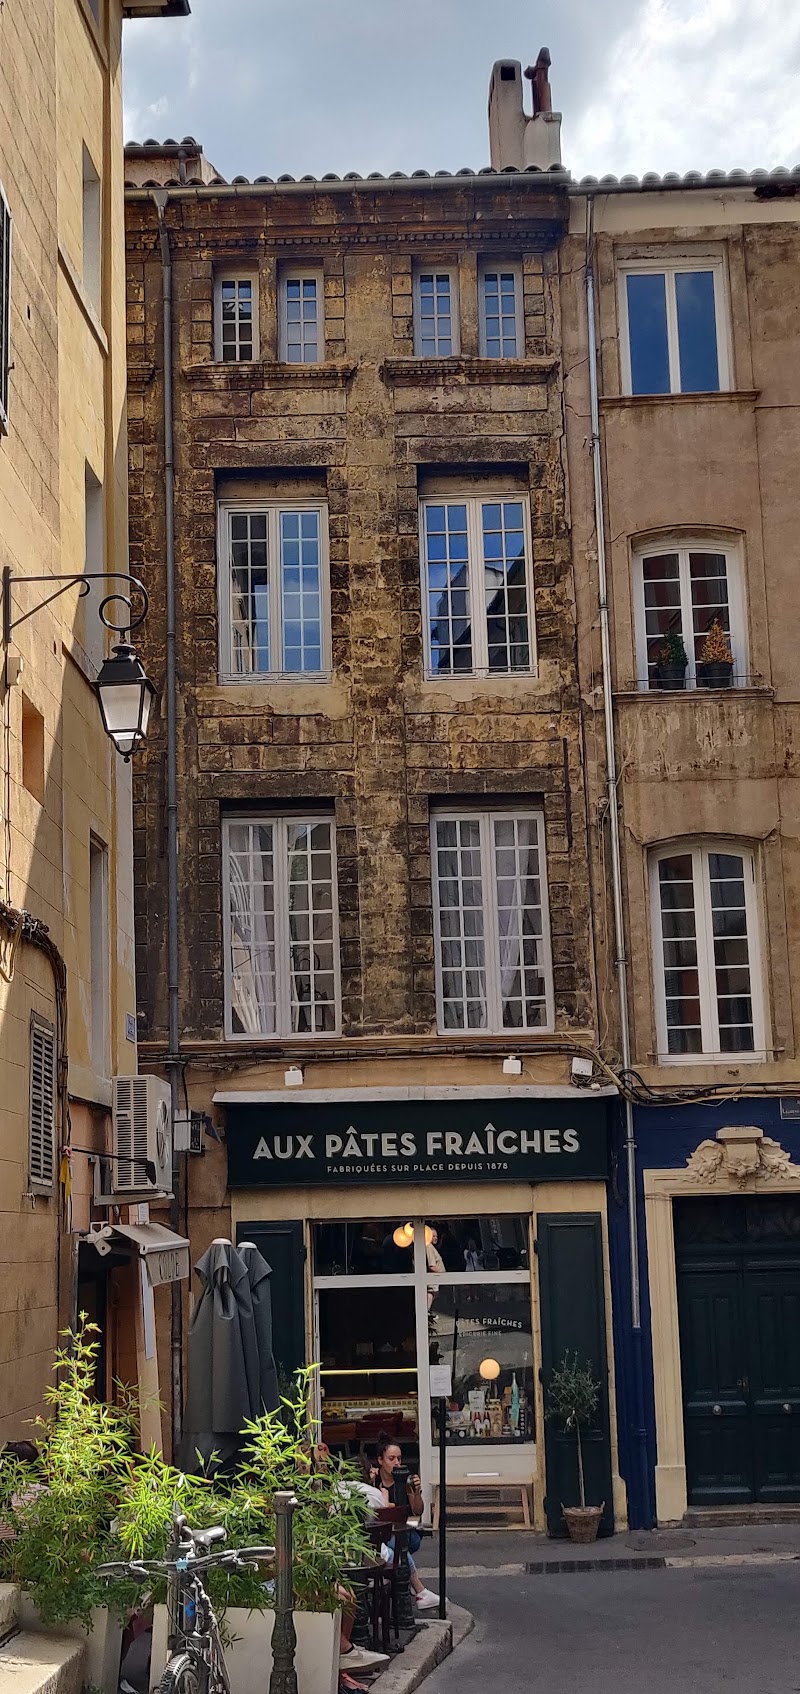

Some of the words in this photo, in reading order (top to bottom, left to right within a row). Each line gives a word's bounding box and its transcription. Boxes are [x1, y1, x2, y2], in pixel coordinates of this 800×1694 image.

[252, 1134, 316, 1160] AUX
[325, 1125, 417, 1158] PÂTES
[426, 1122, 580, 1156] FRAÎCHES
[327, 1163, 388, 1174] FABRIQUÉES
[391, 1164, 410, 1172] SUR
[413, 1163, 444, 1172] PLACE
[448, 1162, 483, 1171] DEPUIS
[486, 1162, 508, 1170] 1878
[482, 1316, 522, 1329] FRAÎCHES
